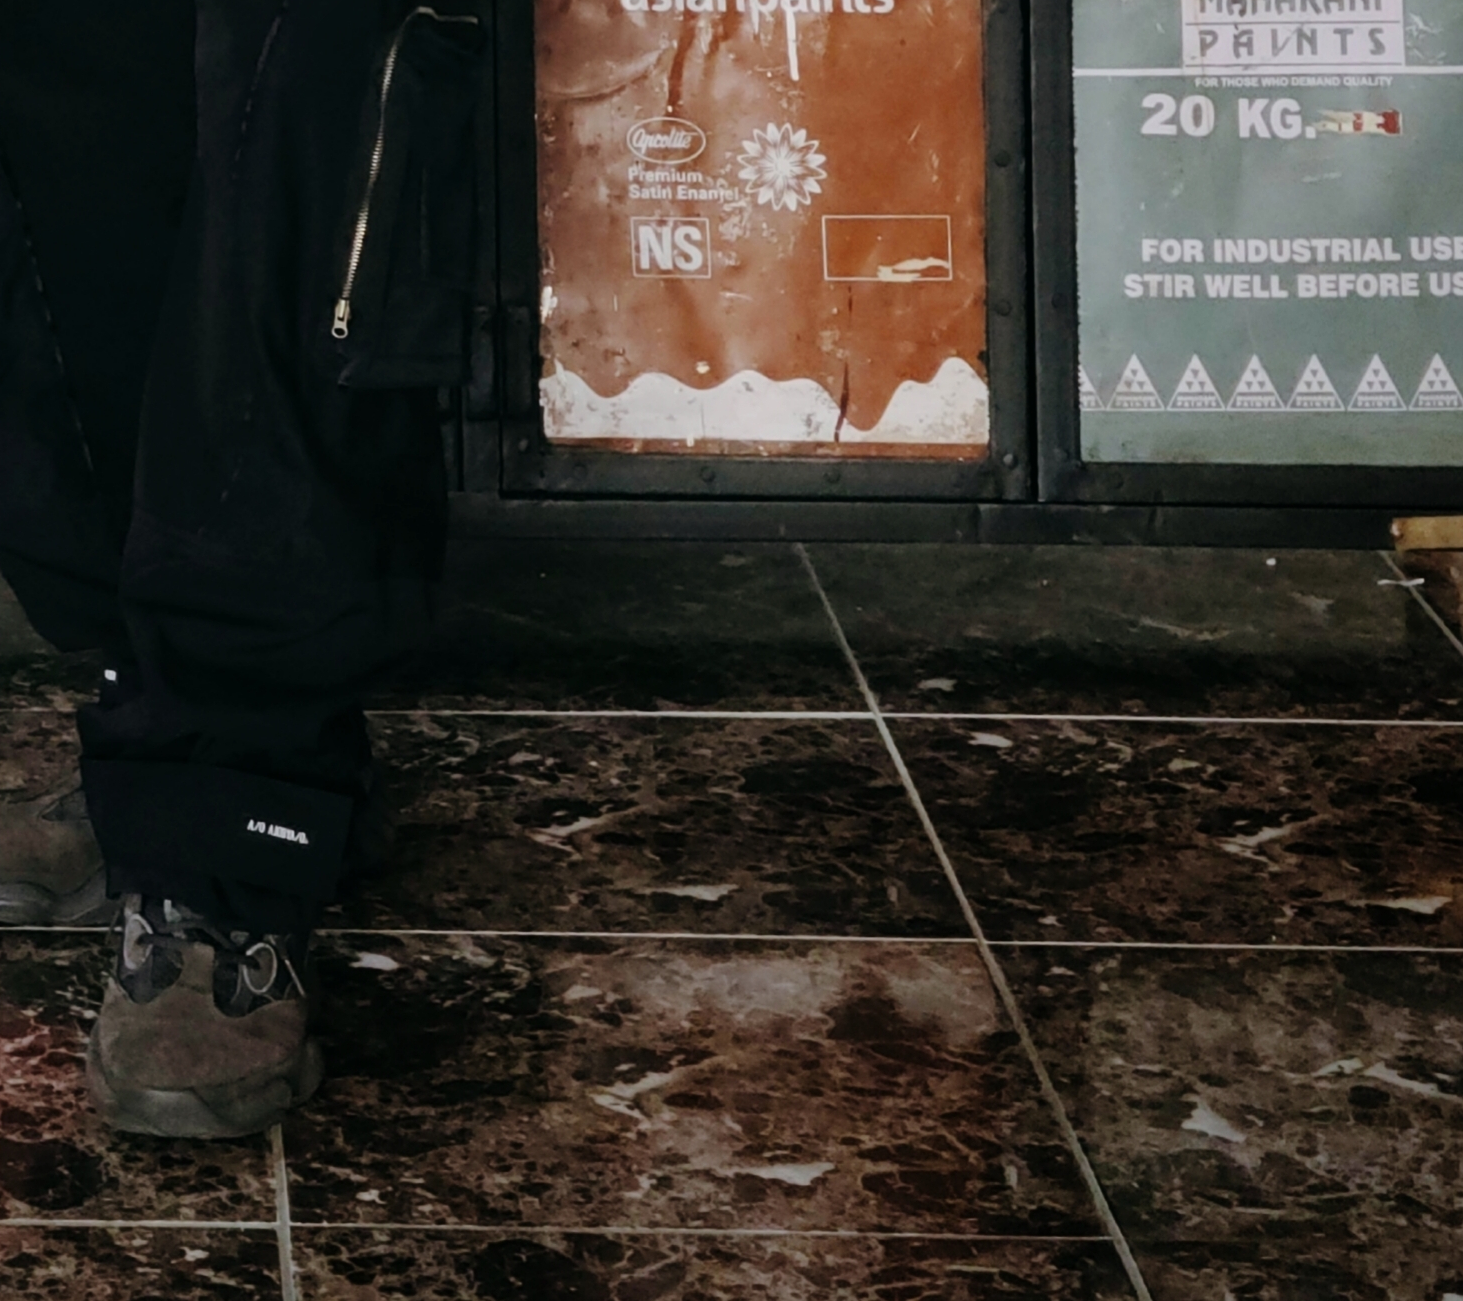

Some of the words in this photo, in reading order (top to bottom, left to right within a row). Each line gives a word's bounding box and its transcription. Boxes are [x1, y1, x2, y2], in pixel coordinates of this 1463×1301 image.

[1199, 27, 1386, 57] PAINTS
[1194, 77, 1219, 87] FOR
[1221, 77, 1259, 87] THOSE
[1261, 76, 1289, 87] WHO
[1291, 76, 1341, 87] DEMAND
[1343, 75, 1393, 87] QUALITY
[1140, 94, 1215, 137] 20
[1237, 96, 1318, 139] KG.
[627, 167, 703, 183] Premium
[628, 184, 673, 200] Satin
[676, 184, 739, 201] Enamel
[638, 224, 704, 273] NS
[1141, 237, 1204, 263] FOR
[1213, 237, 1401, 263] INDUSTRIAL
[1123, 274, 1196, 298] STIR
[1203, 274, 1288, 298] WELL
[1297, 273, 1420, 298] BEFORE
